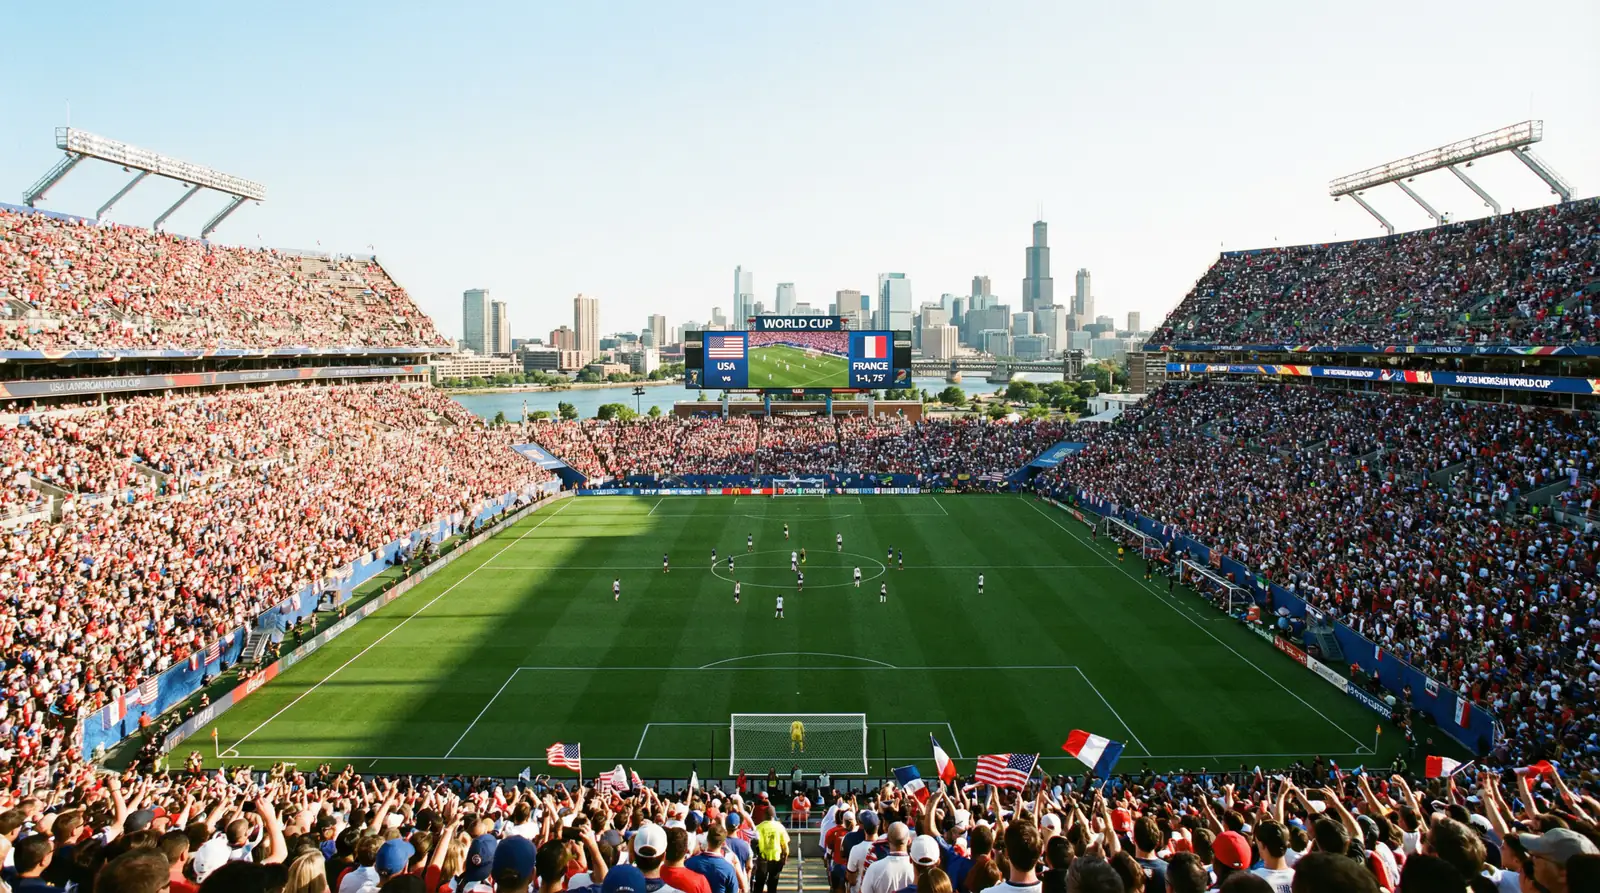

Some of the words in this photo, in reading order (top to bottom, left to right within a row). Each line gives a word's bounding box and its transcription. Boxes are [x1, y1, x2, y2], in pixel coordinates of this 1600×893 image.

[763, 318, 807, 329] WORLD
[809, 318, 833, 329] CUP
[717, 362, 736, 371] USA
[853, 362, 889, 370] FRANCE
[1509, 378, 1534, 388] WORLD
